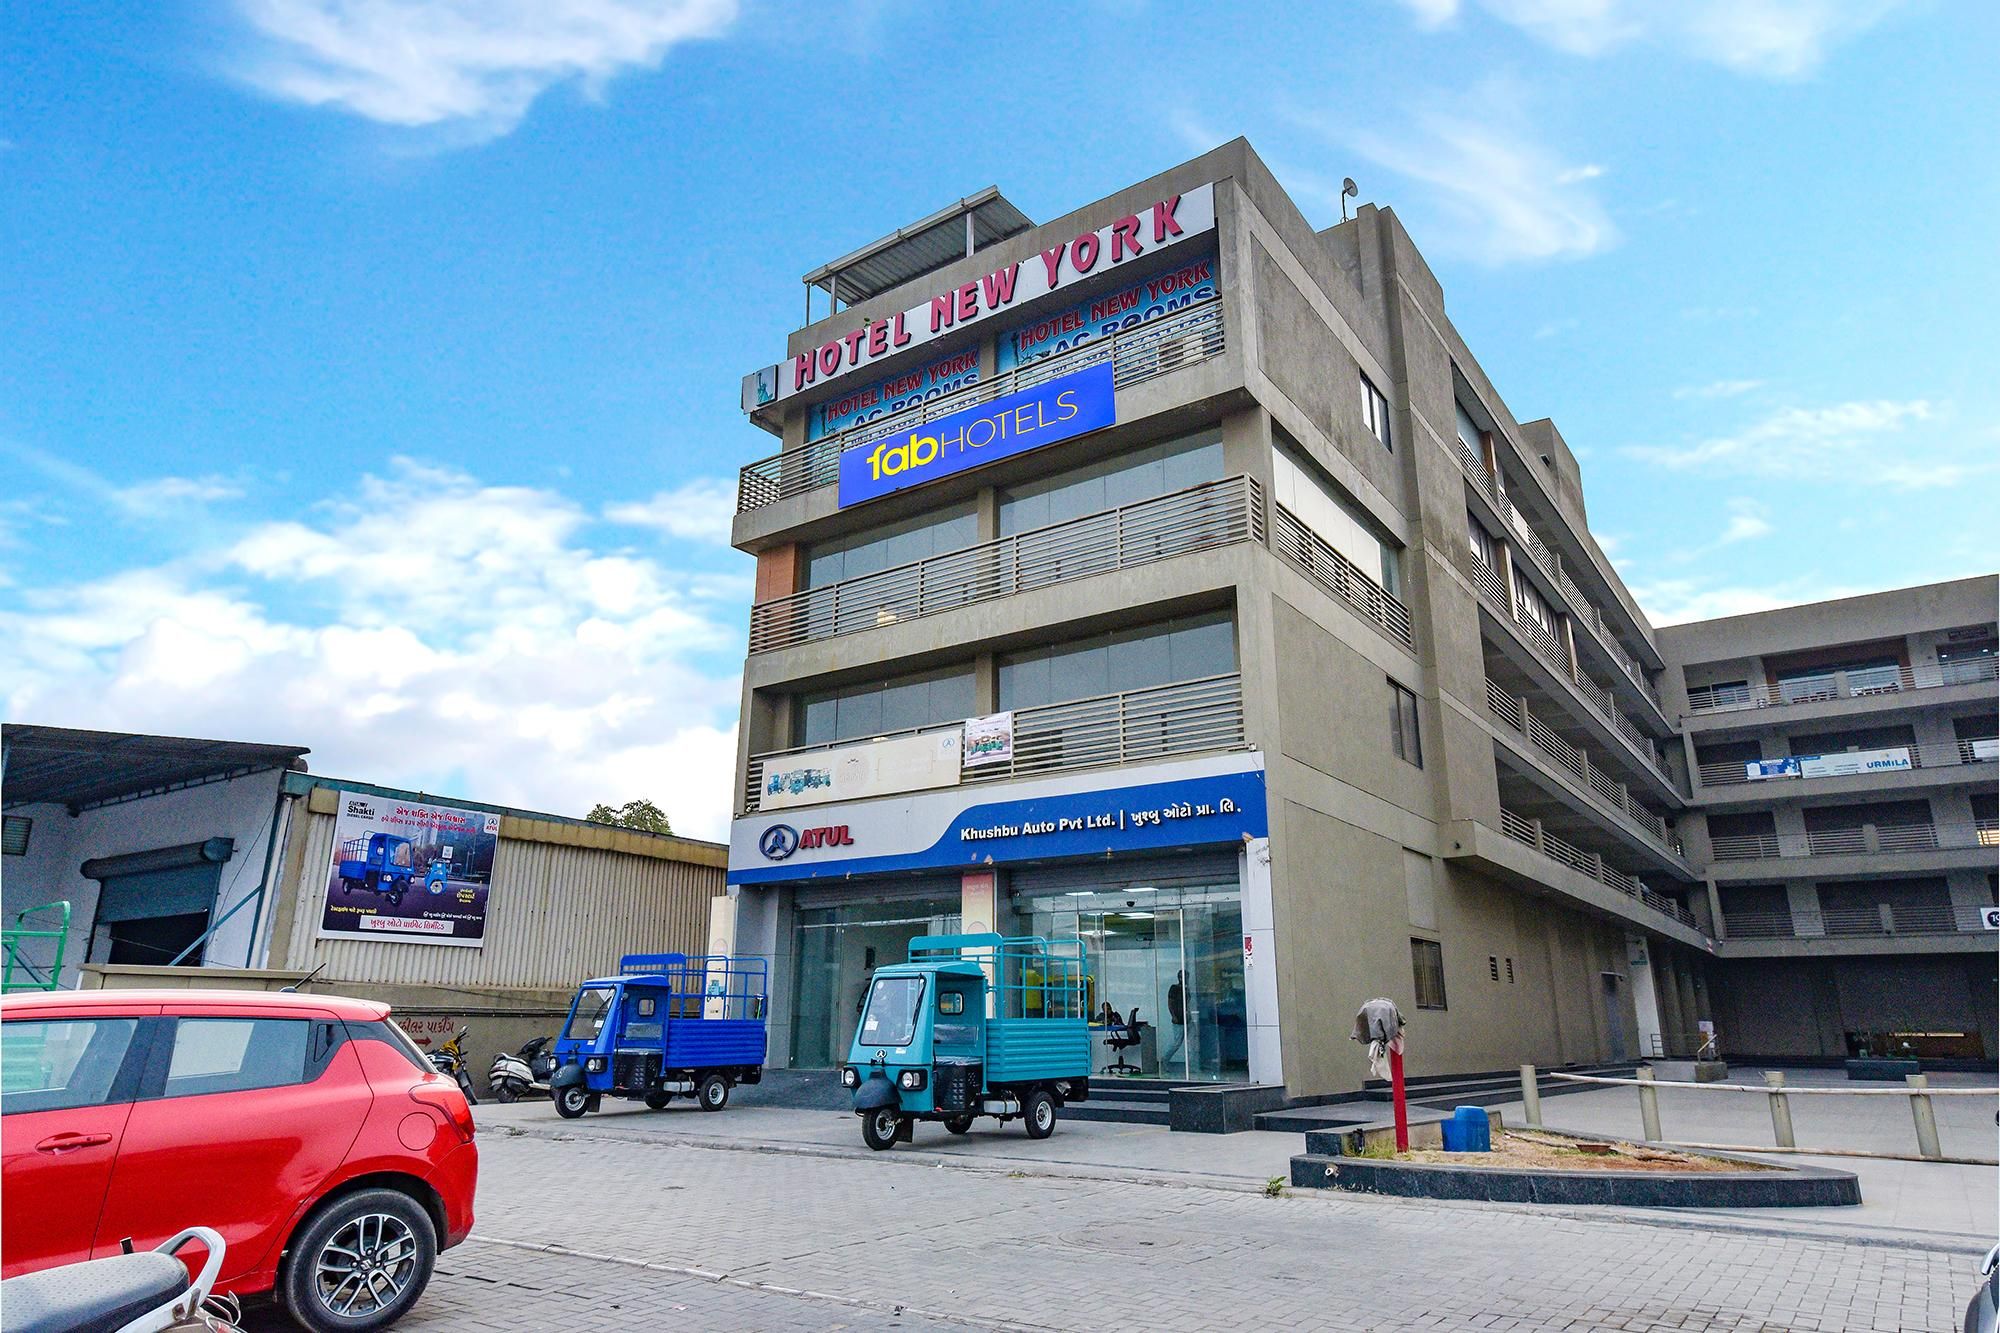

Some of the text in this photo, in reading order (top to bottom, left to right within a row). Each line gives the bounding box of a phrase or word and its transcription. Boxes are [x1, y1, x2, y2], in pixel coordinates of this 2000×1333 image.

[795, 194, 1184, 391] HOTEL NEW YORK
[1020, 311, 1085, 351] HOTEL
[1091, 287, 1140, 322] NEW
[1147, 260, 1211, 301] YORK
[827, 388, 879, 422] HOTEL
[884, 369, 923, 400] NEW
[928, 350, 978, 385] YORK
[347, 805, 375, 816] Shakti
[1163, 802, 1192, 818] ઓટો
[1196, 804, 1215, 816] પ્રા.
[799, 825, 854, 849] ATUL
[960, 815, 1115, 841] Khushbu Auto Pvt Ltd.
